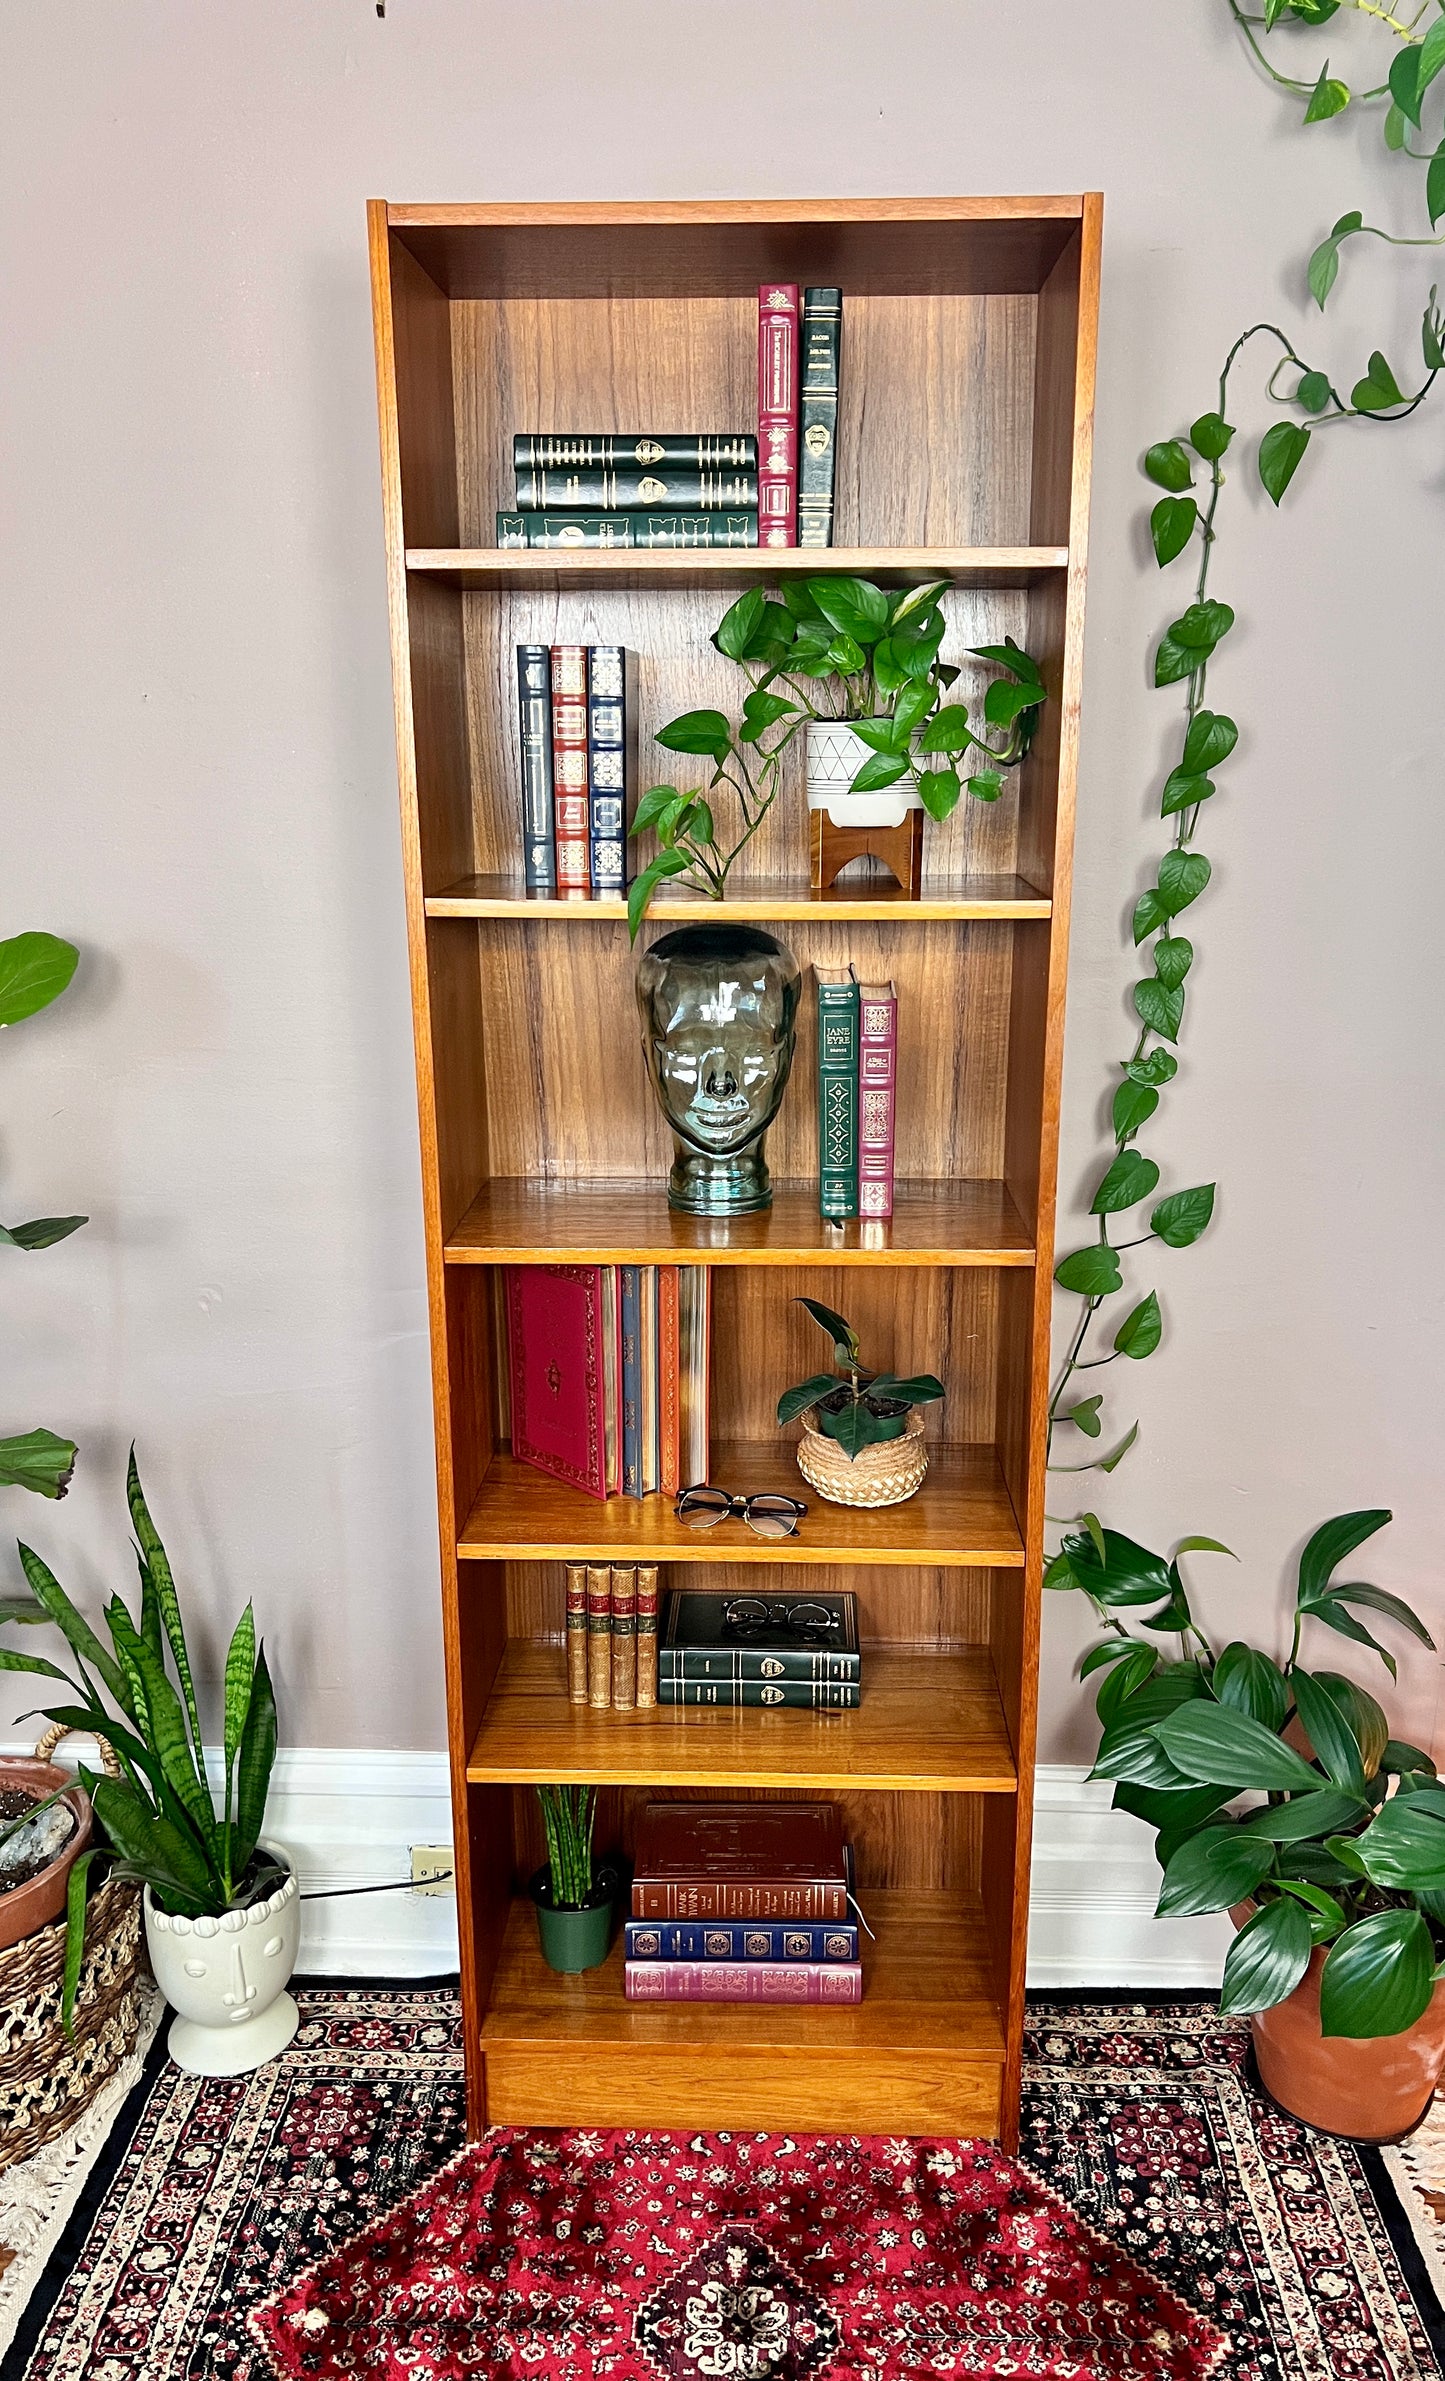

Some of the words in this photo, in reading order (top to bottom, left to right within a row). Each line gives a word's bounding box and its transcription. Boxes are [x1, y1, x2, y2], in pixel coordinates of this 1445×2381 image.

[826, 1028, 850, 1037] JANE
[826, 1036, 850, 1044] EYRE
[678, 1891, 687, 1914] MARK
[688, 1888, 698, 1916] TWAIN
